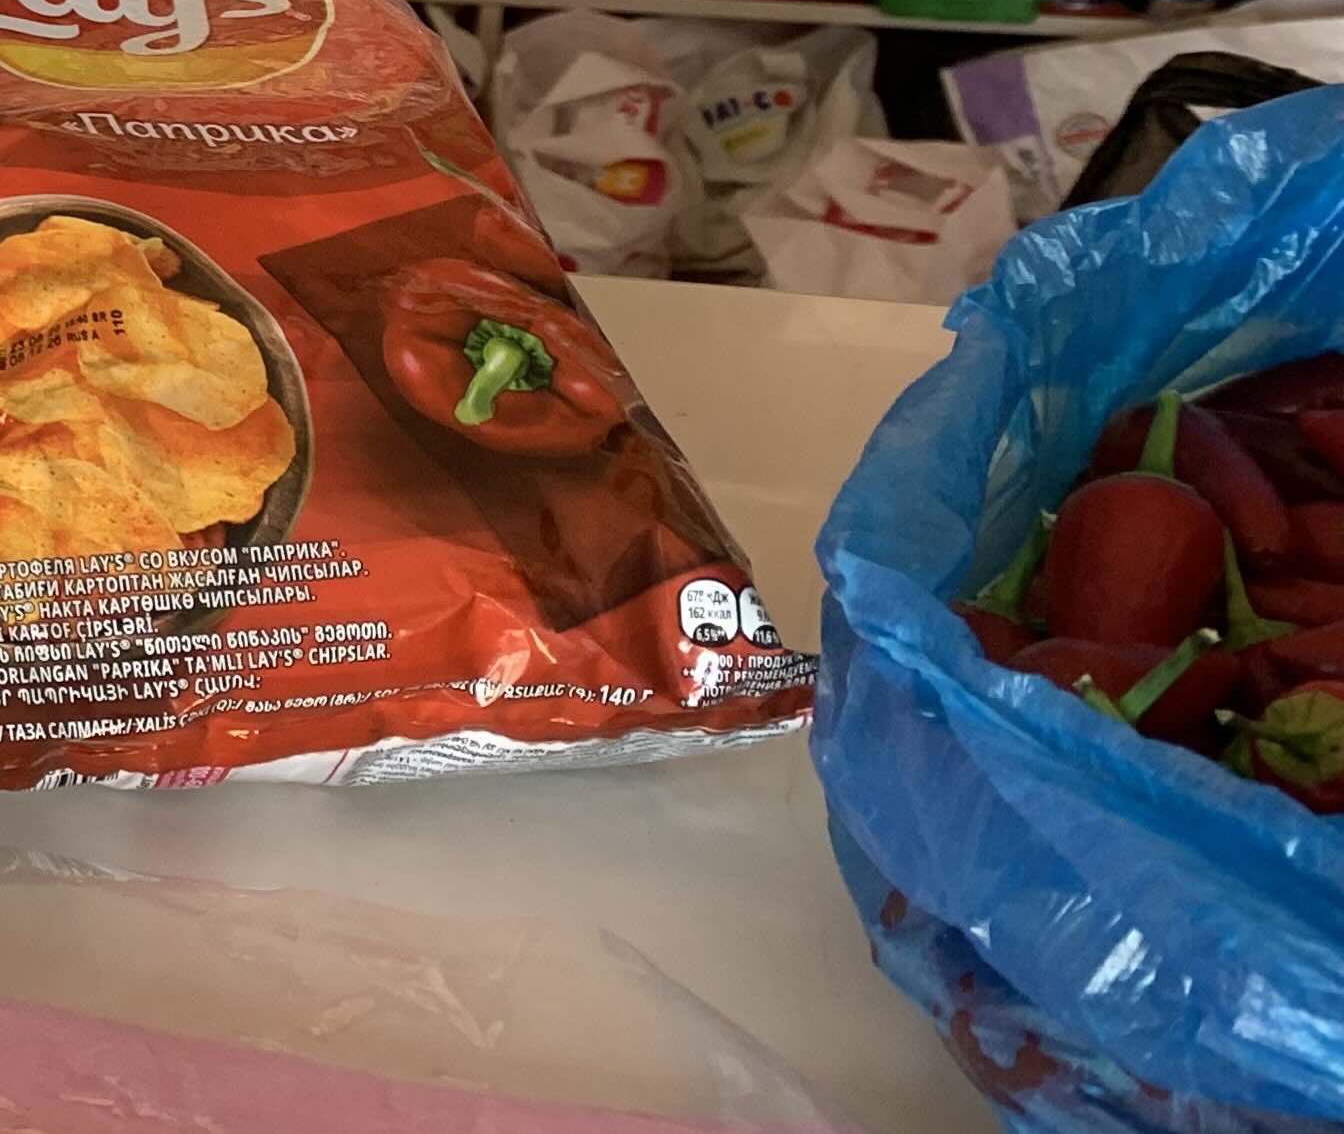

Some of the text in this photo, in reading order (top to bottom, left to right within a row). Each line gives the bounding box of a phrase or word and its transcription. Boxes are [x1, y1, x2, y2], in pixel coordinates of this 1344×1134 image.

[61, 111, 359, 147] «Паприка»
[140, 553, 162, 569] СО
[168, 548, 238, 567] ВКУСОМ
[64, 574, 163, 596] КАРТОПТАН
[39, 599, 93, 618] НАКТА
[688, 608, 705, 619] 162
[9, 622, 71, 644] KARTOF
[184, 653, 244, 674] TA'MLI
[308, 643, 391, 665] CHIPSLAR.
[7, 722, 46, 740] ТАЗА
[599, 685, 635, 706] 140
